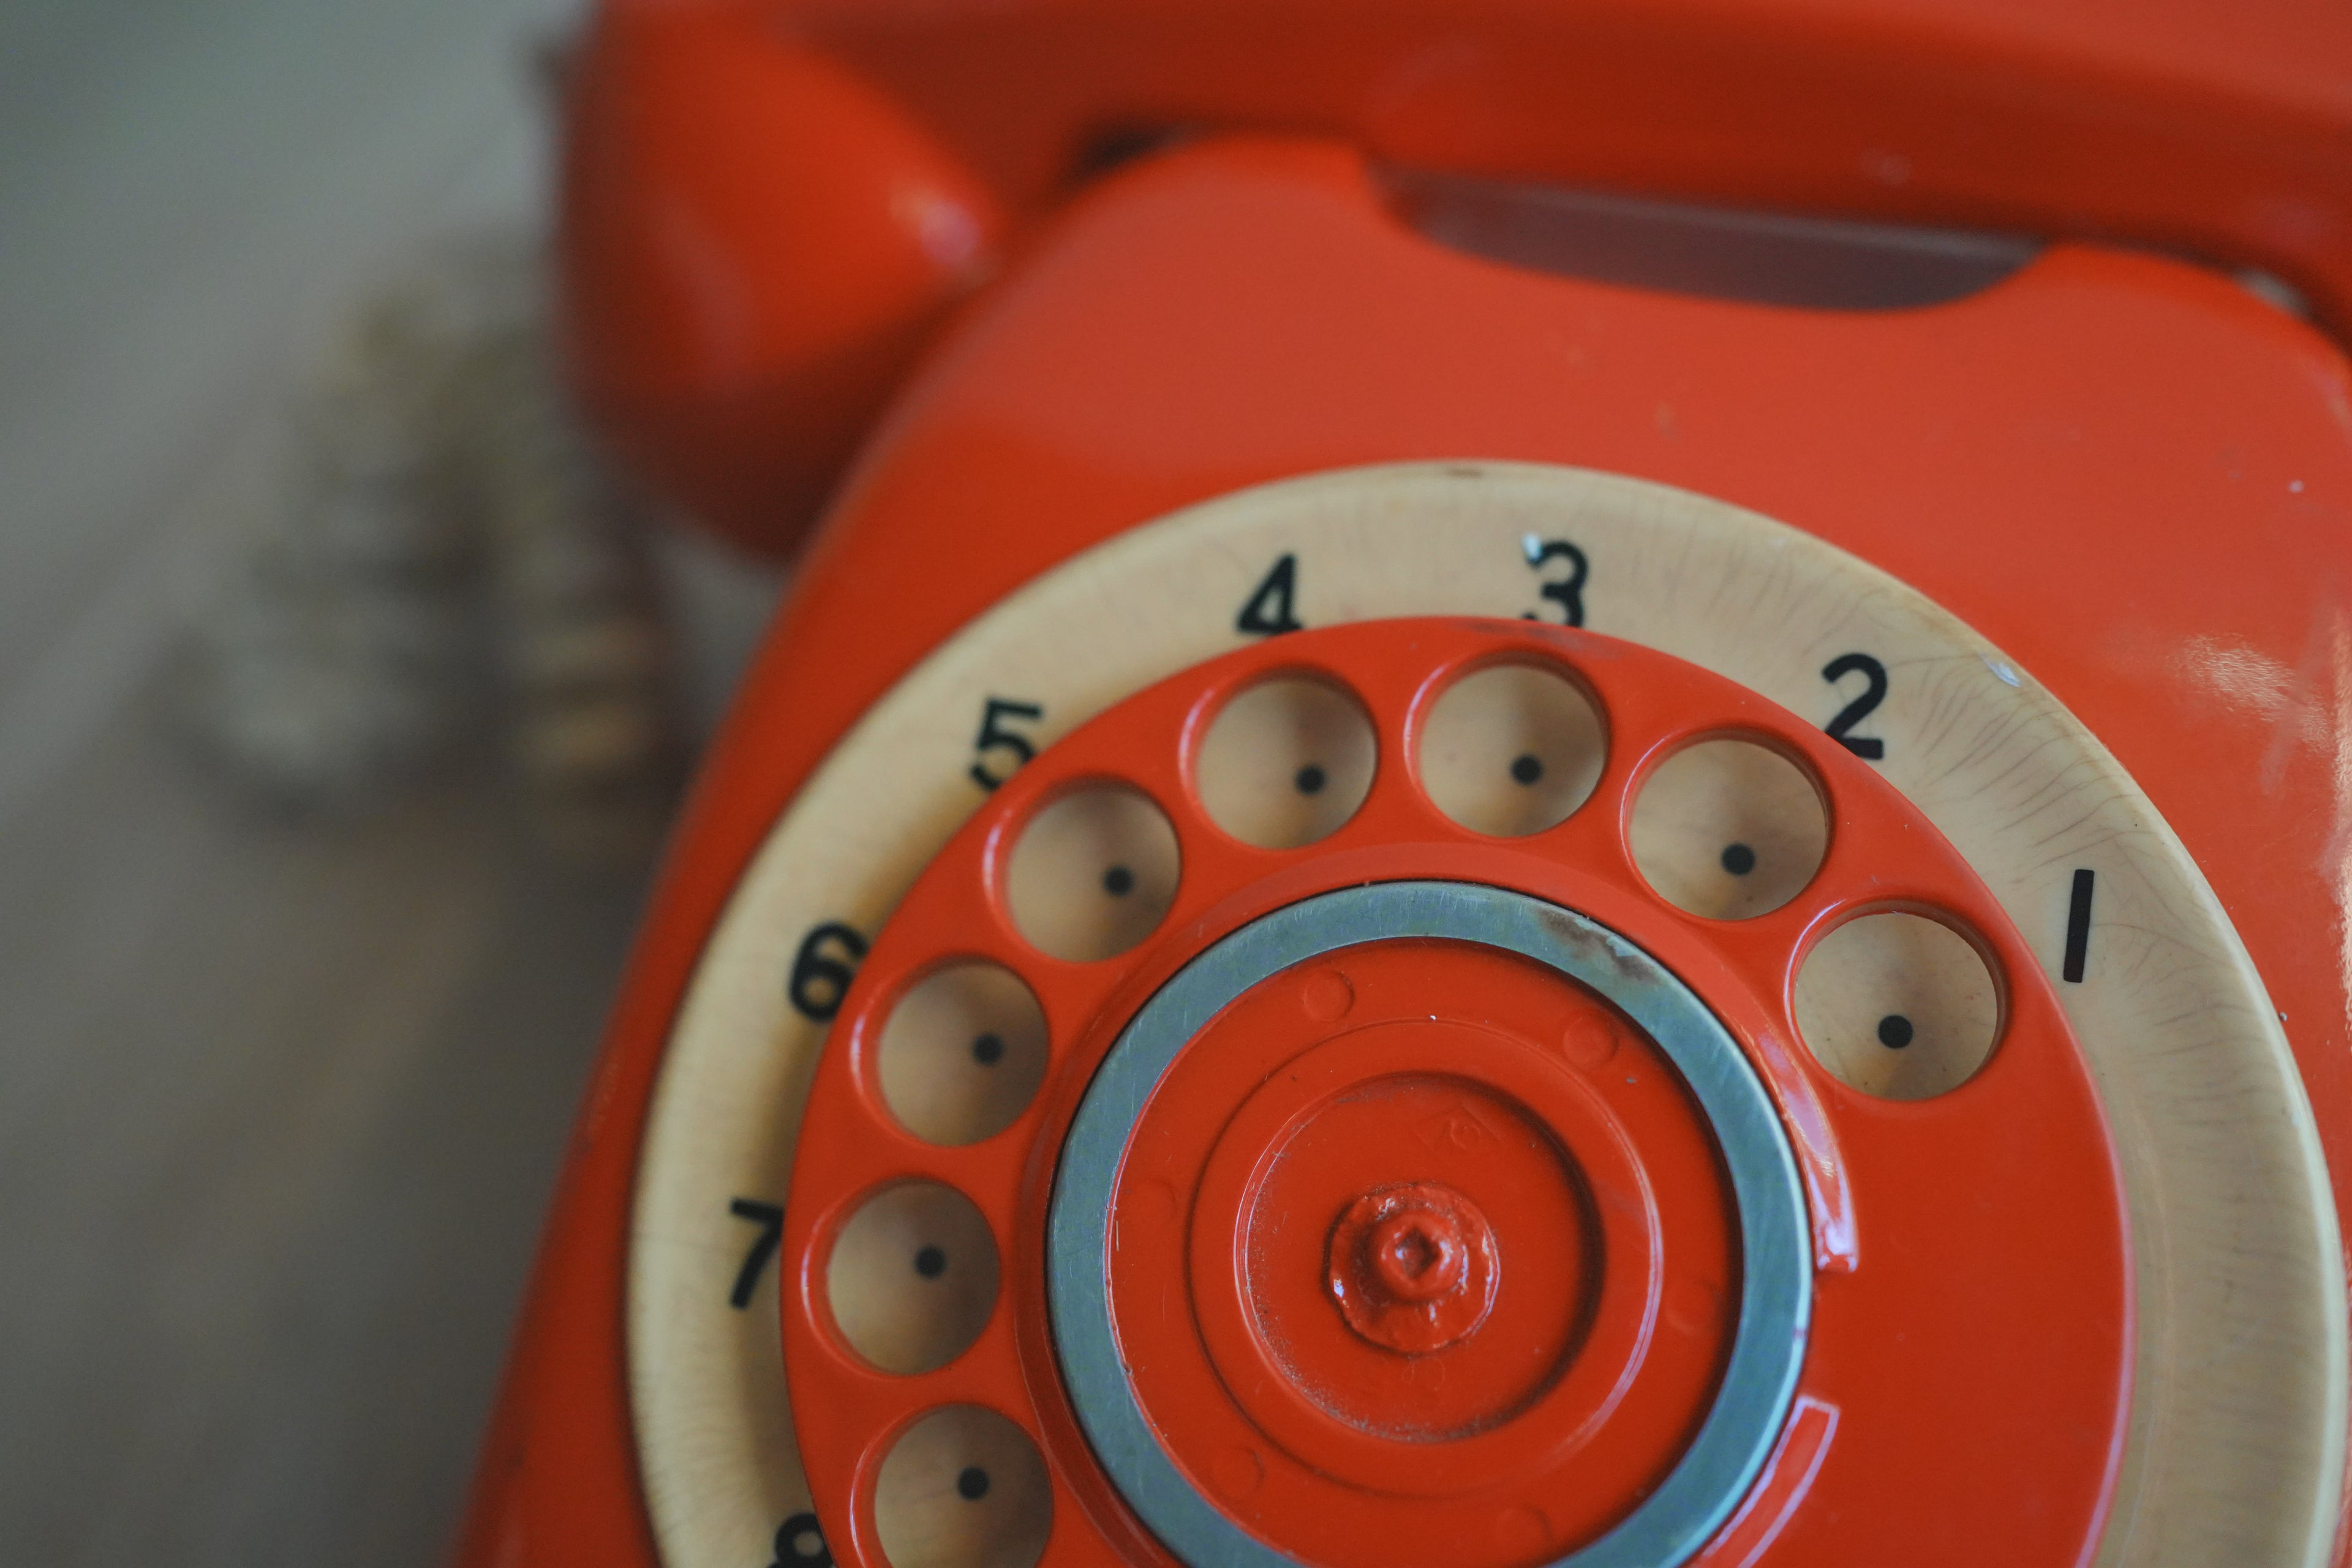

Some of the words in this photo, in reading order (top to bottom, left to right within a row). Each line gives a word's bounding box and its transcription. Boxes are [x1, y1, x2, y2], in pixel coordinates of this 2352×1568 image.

[1235, 553, 1303, 635] 4
[1522, 539, 1588, 628] 3
[970, 698, 1042, 793] 5
[1822, 652, 1888, 761] 2
[788, 921, 870, 1024] 6
[2062, 869, 2095, 984] 1
[729, 1196, 784, 1311] 7
